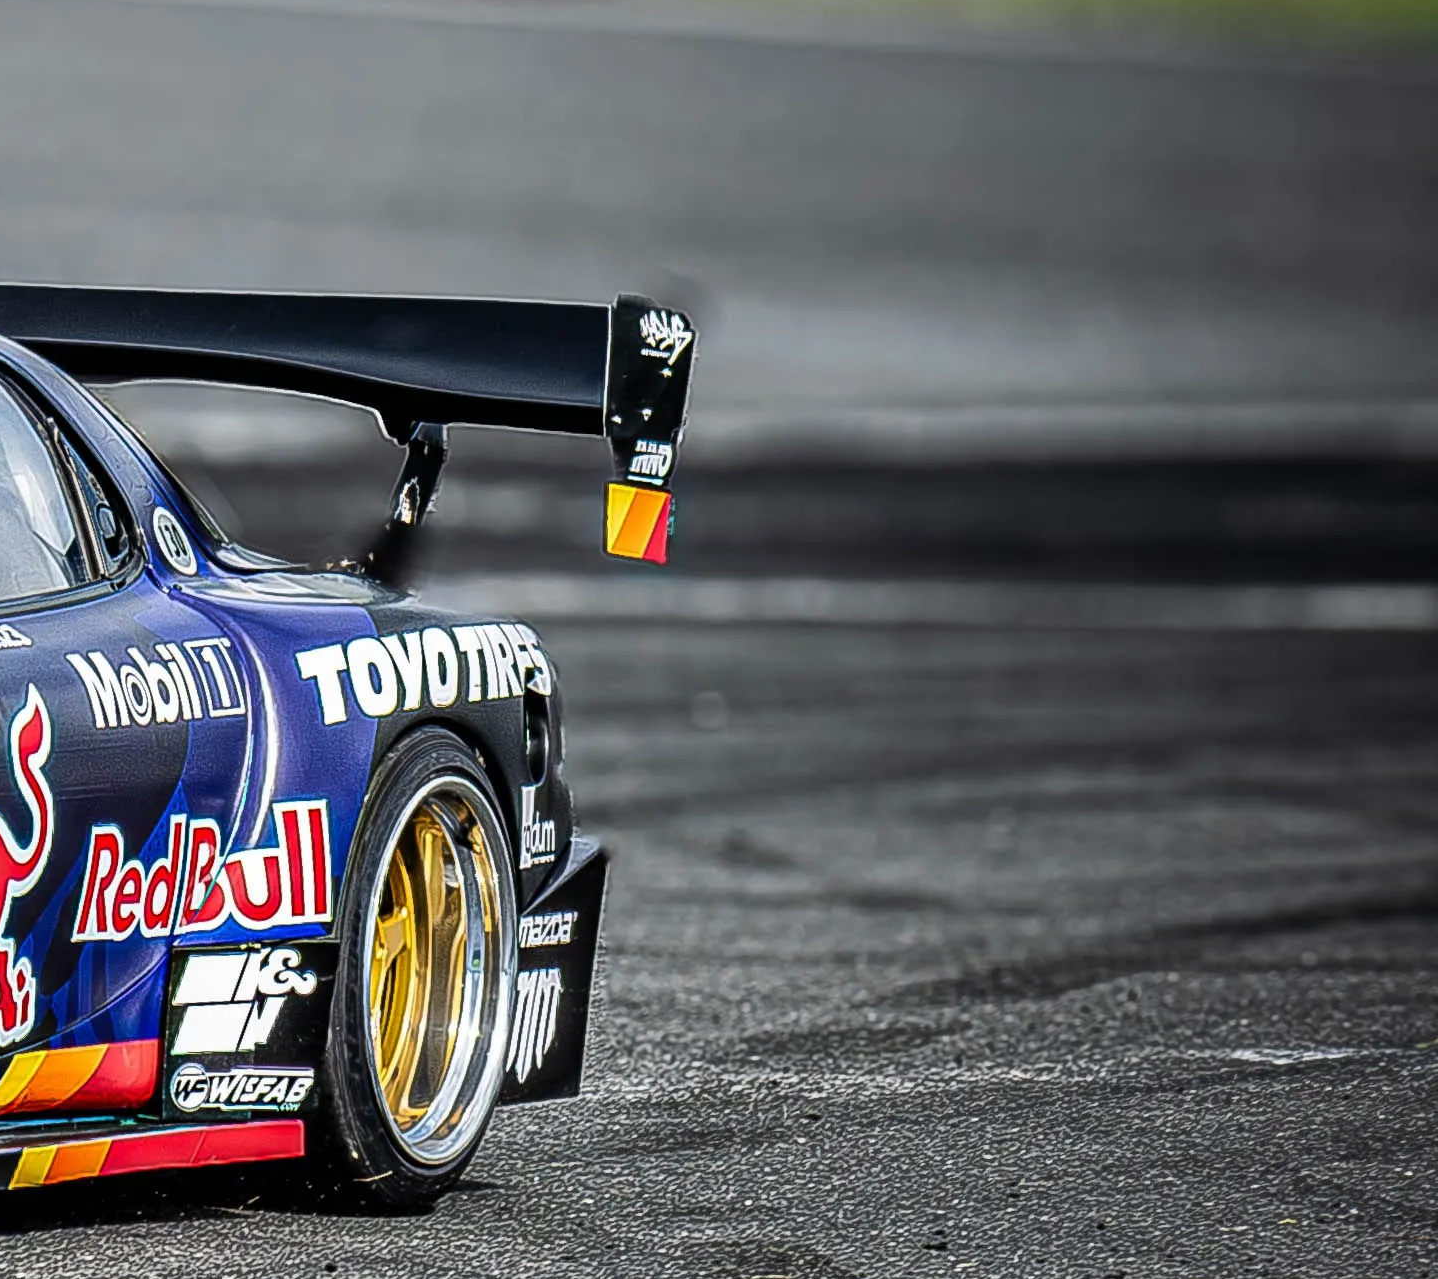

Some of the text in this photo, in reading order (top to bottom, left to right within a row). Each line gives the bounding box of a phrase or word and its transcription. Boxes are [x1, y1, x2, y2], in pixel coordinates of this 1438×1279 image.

[65, 642, 204, 729] Mobil
[294, 627, 459, 726] TOYO
[71, 799, 334, 943] Red Bull
[209, 1075, 314, 1103] WISEFAB
